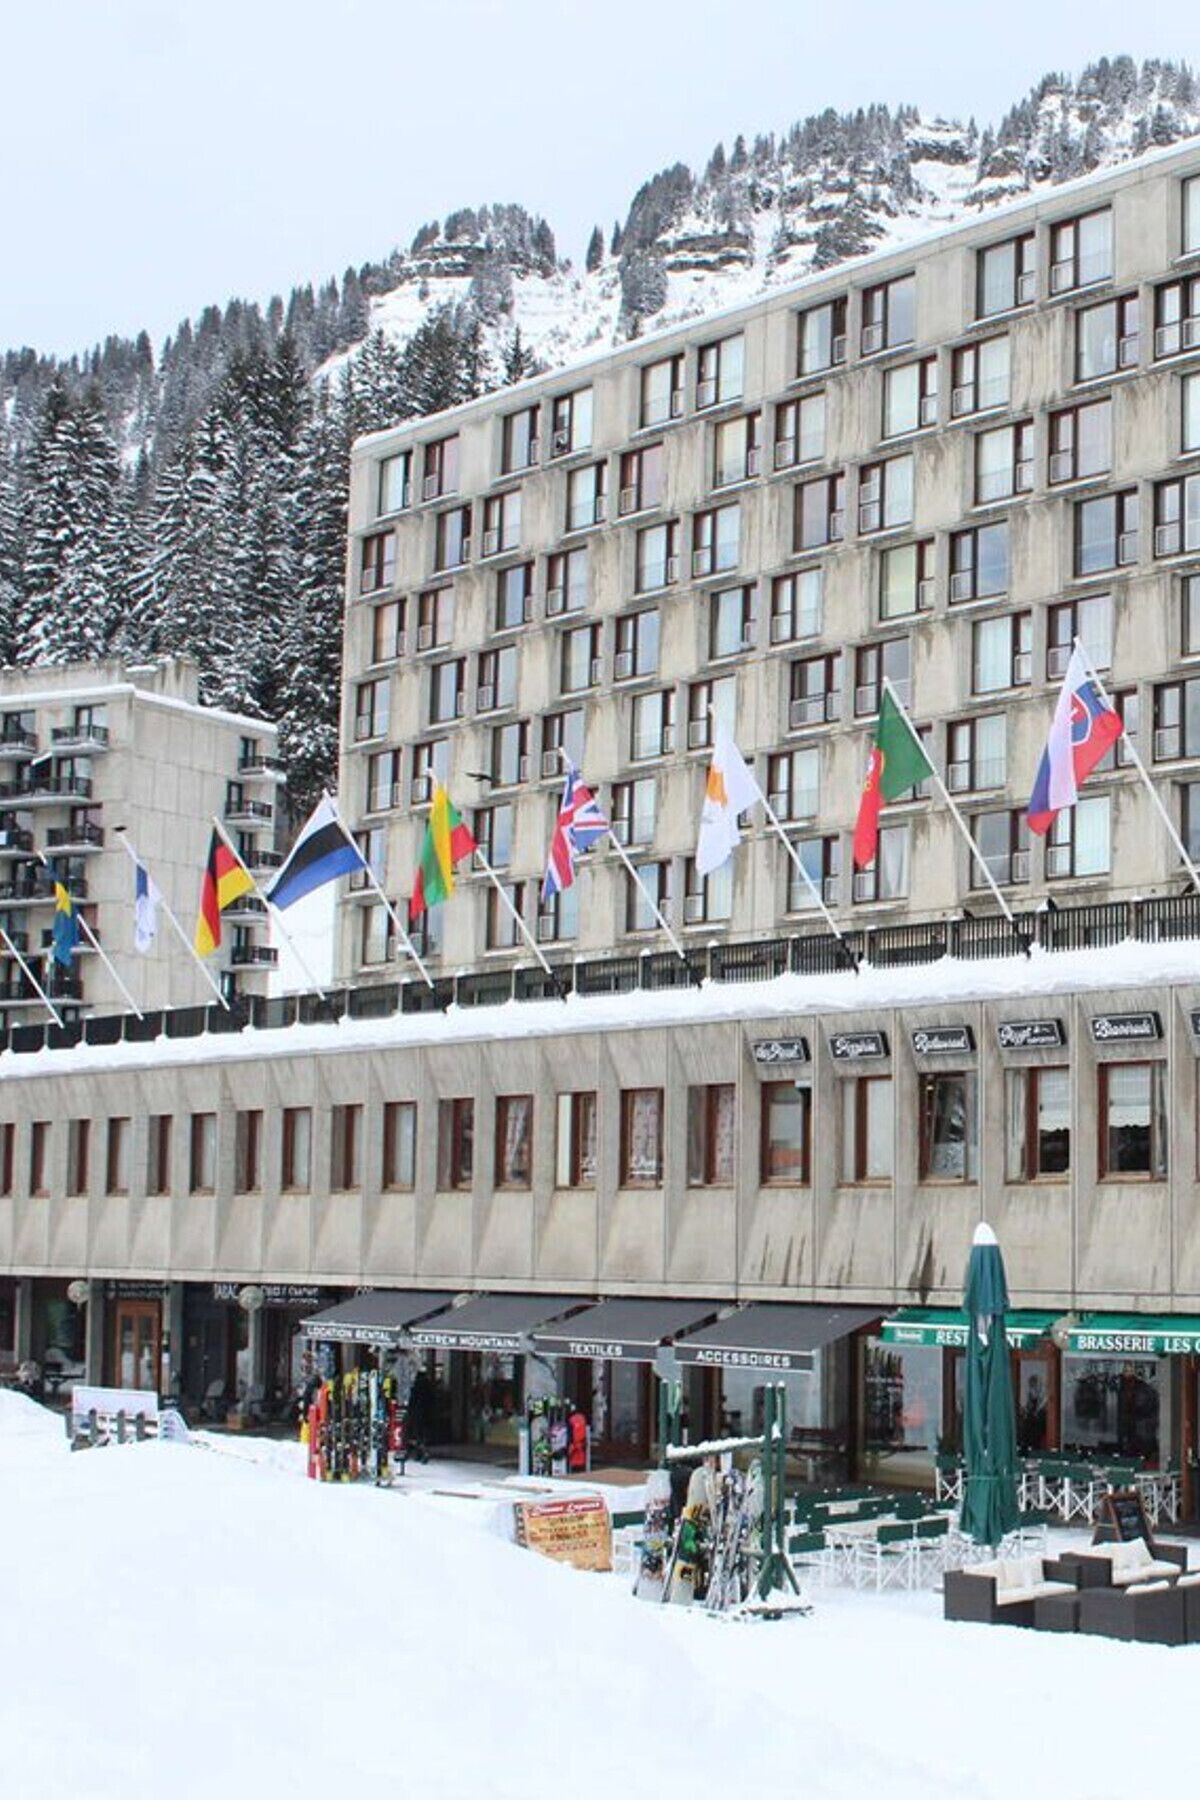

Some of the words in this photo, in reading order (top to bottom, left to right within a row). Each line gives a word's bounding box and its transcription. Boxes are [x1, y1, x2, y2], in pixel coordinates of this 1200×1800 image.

[936, 1331, 1024, 1348] RESTNT
[1077, 1335, 1155, 1351] BRASSERIE
[1164, 1337, 1191, 1352] LES
[569, 1342, 623, 1356] TEXTILES
[696, 1350, 791, 1367] ACCESSOIRES
